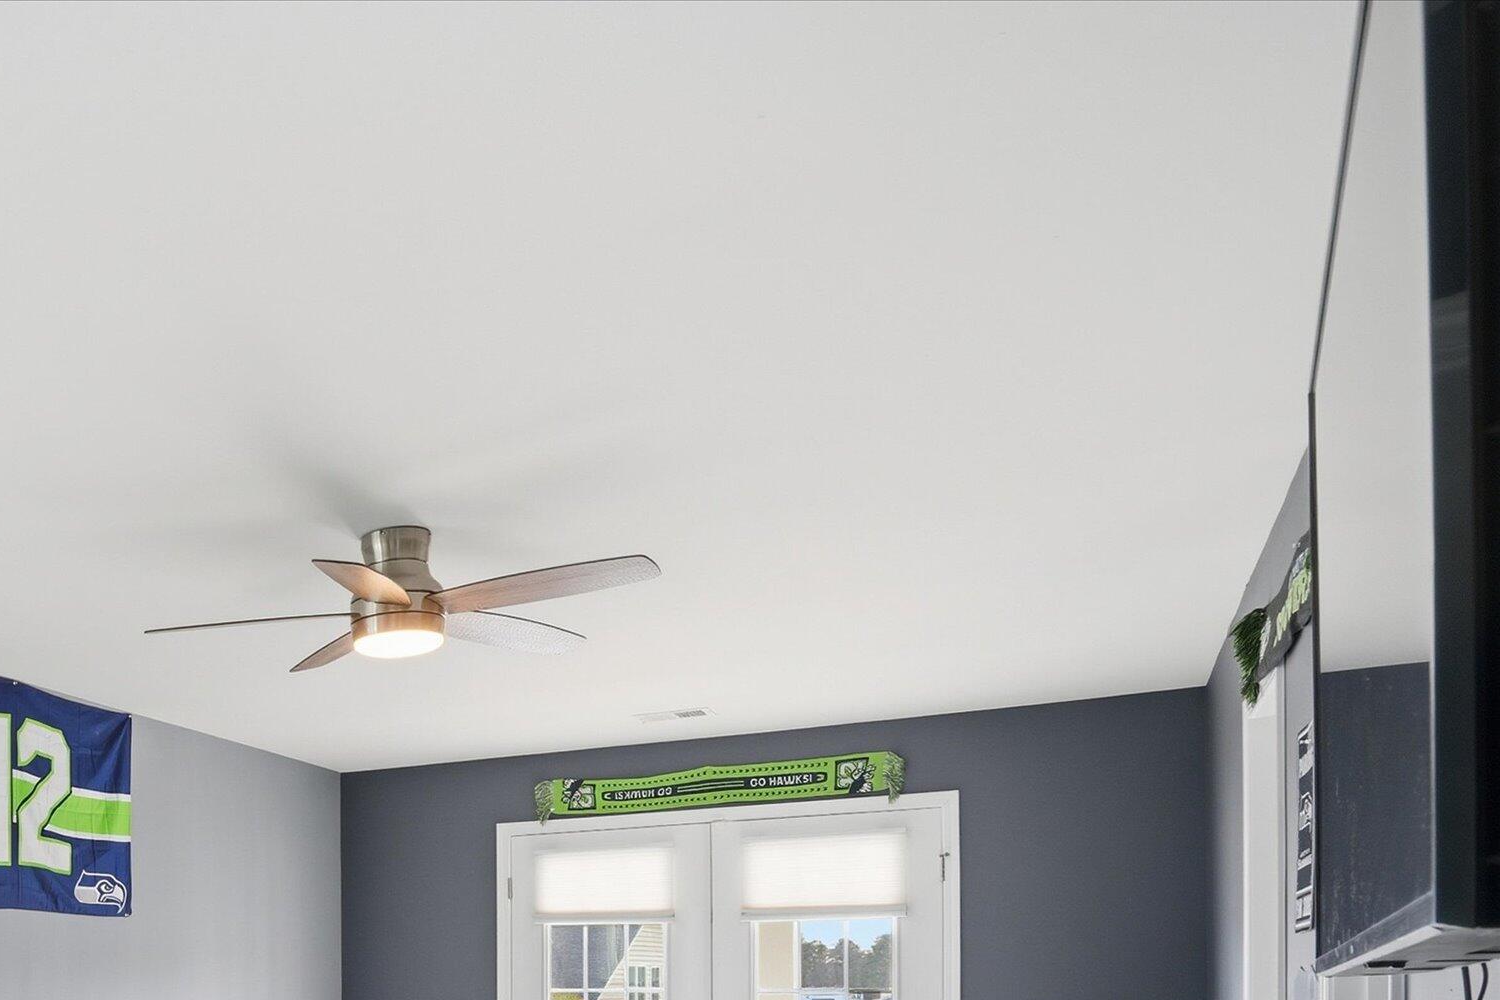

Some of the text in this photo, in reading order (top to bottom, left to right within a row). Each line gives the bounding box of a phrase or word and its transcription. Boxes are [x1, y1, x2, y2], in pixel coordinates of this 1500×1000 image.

[749, 773, 813, 788] GO HAWKS!
[657, 786, 673, 797] GO
